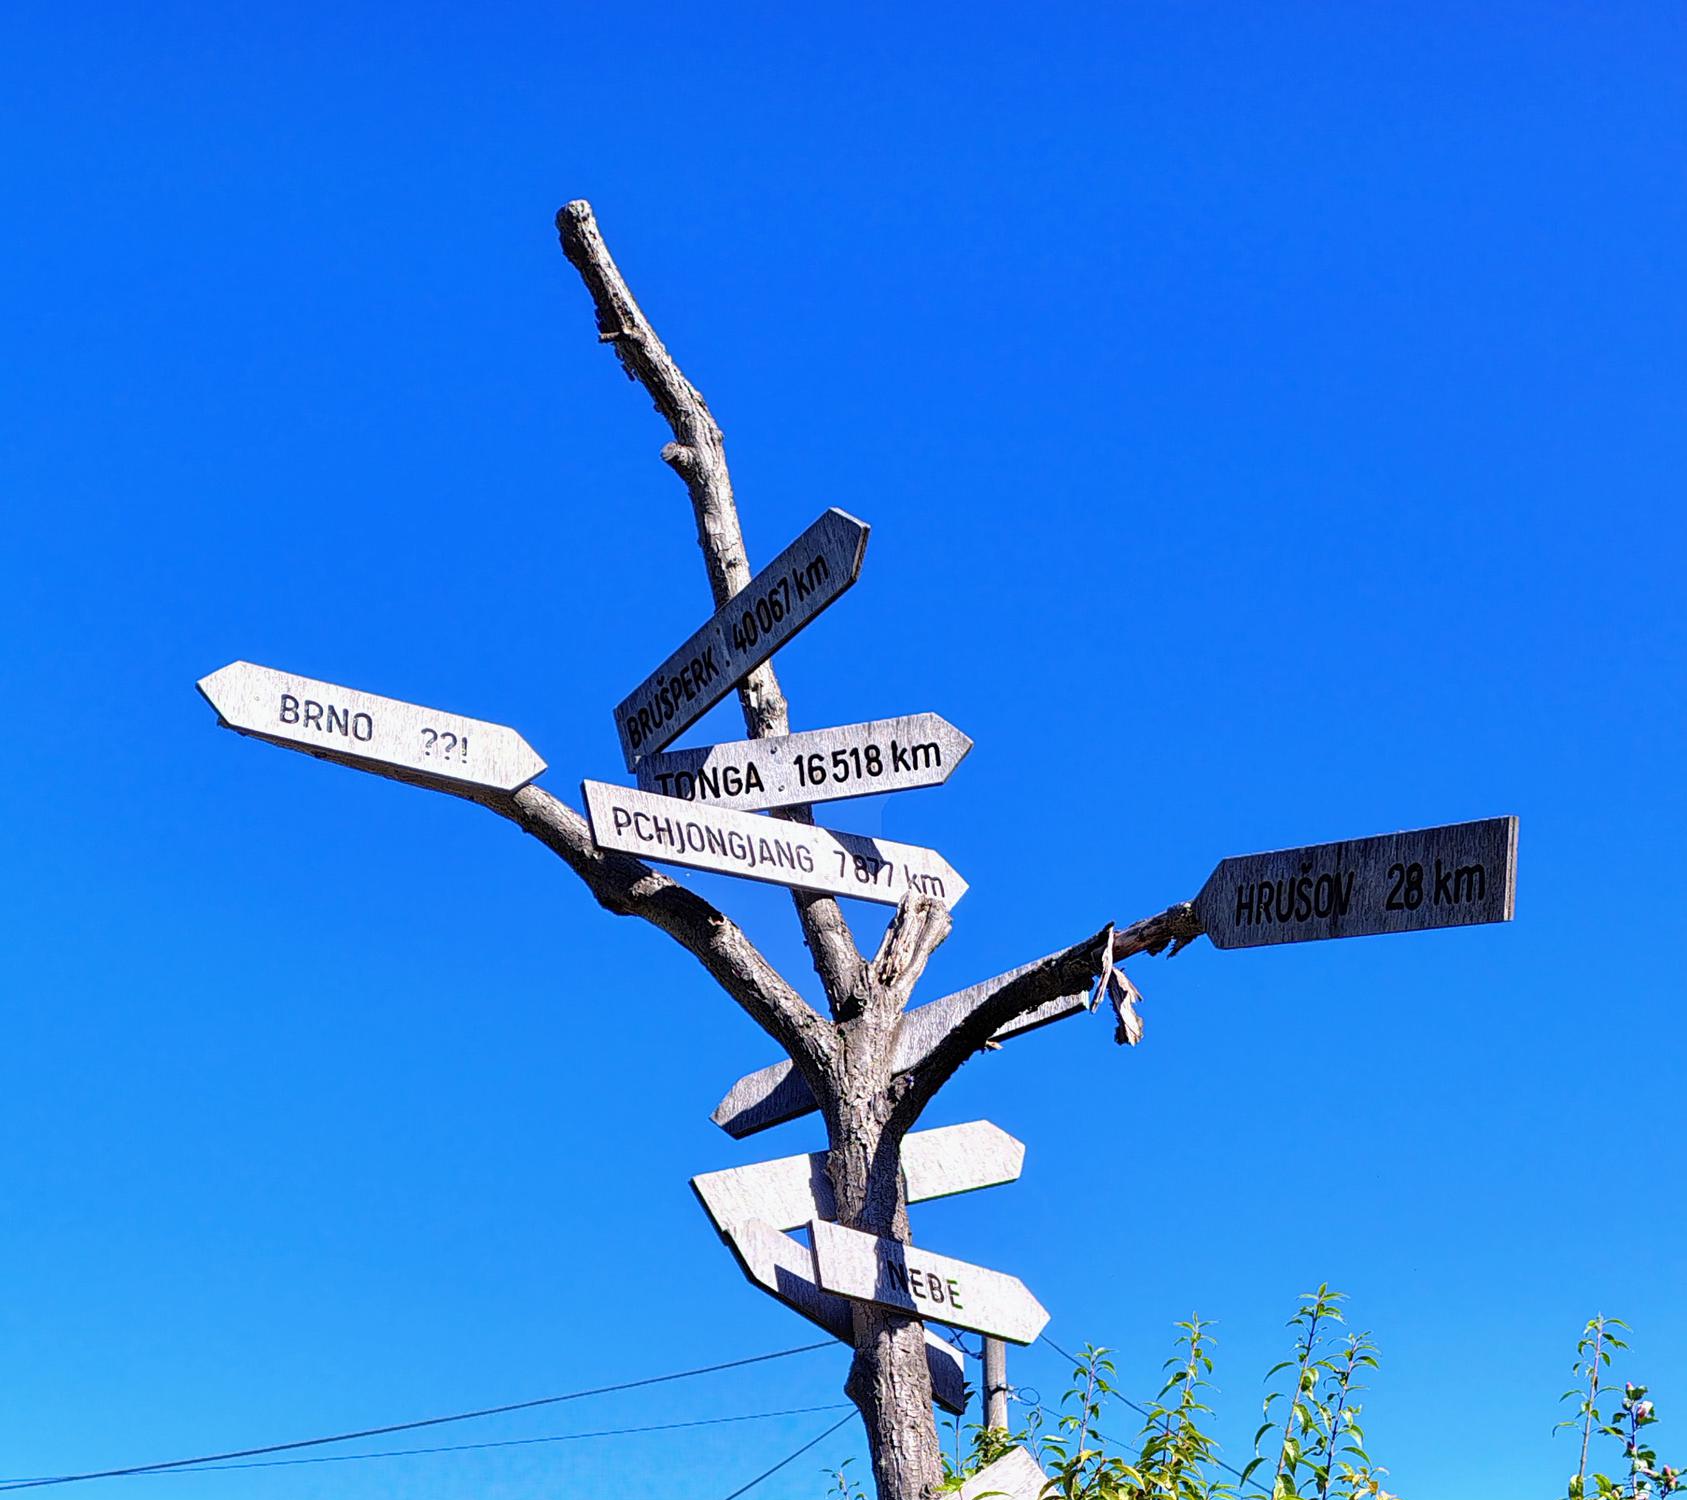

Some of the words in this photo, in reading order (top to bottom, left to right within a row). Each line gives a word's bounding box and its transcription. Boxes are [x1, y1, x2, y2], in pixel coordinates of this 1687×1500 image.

[626, 645, 720, 750] BRUŠPERK
[792, 554, 829, 602] km
[279, 694, 373, 742] BRNO
[420, 727, 469, 764] ??!
[654, 761, 765, 802] TONGA
[891, 740, 941, 773] km
[612, 806, 815, 873] PCHJONGJANG
[904, 864, 946, 898] km
[1235, 862, 1354, 927] HRUŠOV
[1386, 863, 1424, 911] 28
[1434, 859, 1486, 906] km
[886, 1259, 964, 1310] NEBE
